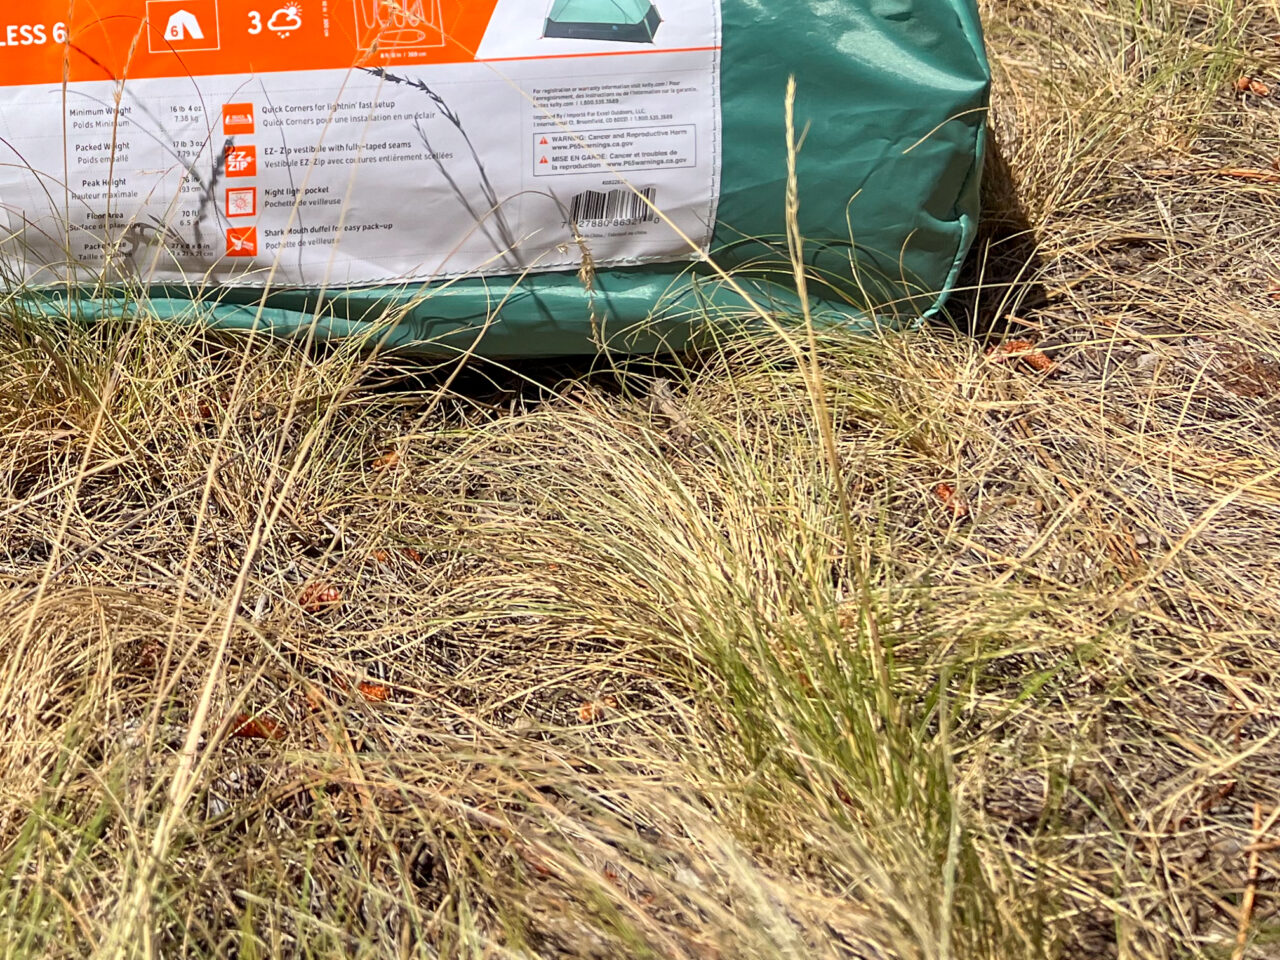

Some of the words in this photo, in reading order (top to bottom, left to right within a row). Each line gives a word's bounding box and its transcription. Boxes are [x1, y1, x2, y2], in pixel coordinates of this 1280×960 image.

[247, 10, 262, 35] 3
[52, 22, 67, 43] 6
[170, 25, 179, 38] 6
[69, 108, 104, 117] Minimum
[106, 106, 132, 117] Weght
[262, 105, 283, 114] Quick
[285, 104, 313, 113] Corners
[315, 103, 325, 111] for
[358, 101, 372, 109] fast
[374, 100, 396, 109] setup
[73, 121, 94, 129] Poids
[95, 120, 130, 128] Minium
[262, 119, 284, 127] Quick
[285, 117, 314, 126] Corners
[315, 116, 333, 126] pour
[75, 143, 102, 152] Packed
[103, 142, 130, 152] Wight
[328, 143, 345, 152] with
[77, 156, 99, 165] Poids
[100, 155, 128, 163] emallé
[228, 152, 245, 161] EZ
[228, 161, 248, 172] ZIP
[264, 159, 298, 169] Vestibule
[286, 187, 301, 196] ligh
[305, 186, 329, 195] pocket
[308, 198, 342, 206] veilleuse
[578, 220, 609, 228] 27880
[264, 229, 285, 237] Shark
[309, 225, 331, 234] duffel
[331, 224, 342, 232] fo
[344, 224, 361, 232] easy
[362, 223, 393, 231] pack-up
